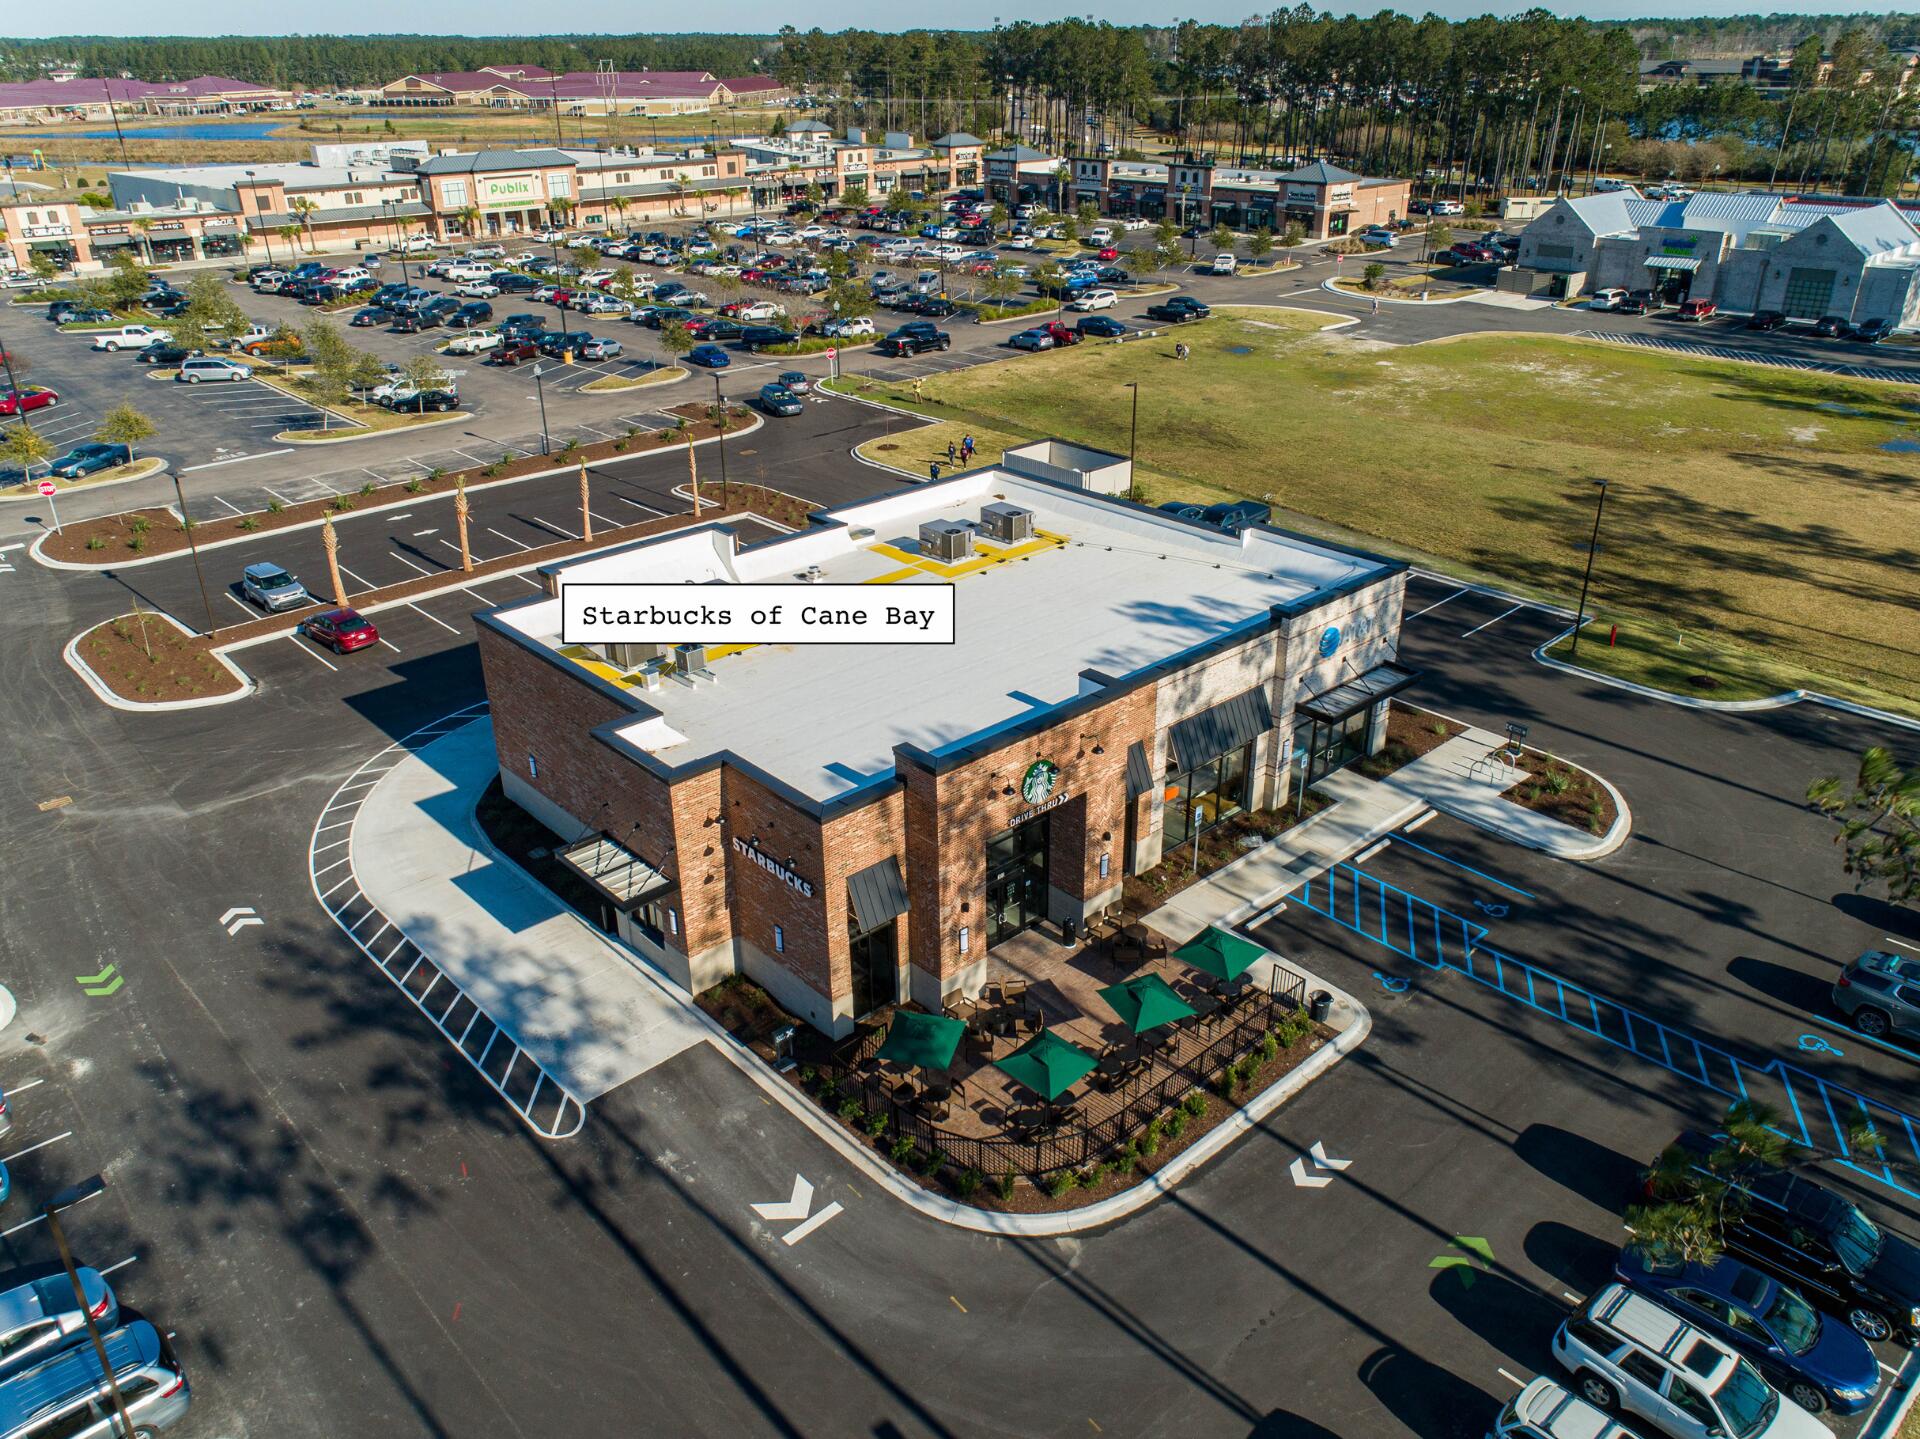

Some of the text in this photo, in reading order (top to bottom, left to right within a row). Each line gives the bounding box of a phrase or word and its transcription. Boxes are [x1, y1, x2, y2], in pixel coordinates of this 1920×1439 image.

[491, 182, 529, 195] Publix
[1342, 614, 1376, 643] AT&T
[1009, 797, 1058, 827] DRIVE THRU
[732, 837, 813, 898] STARBUCKS
